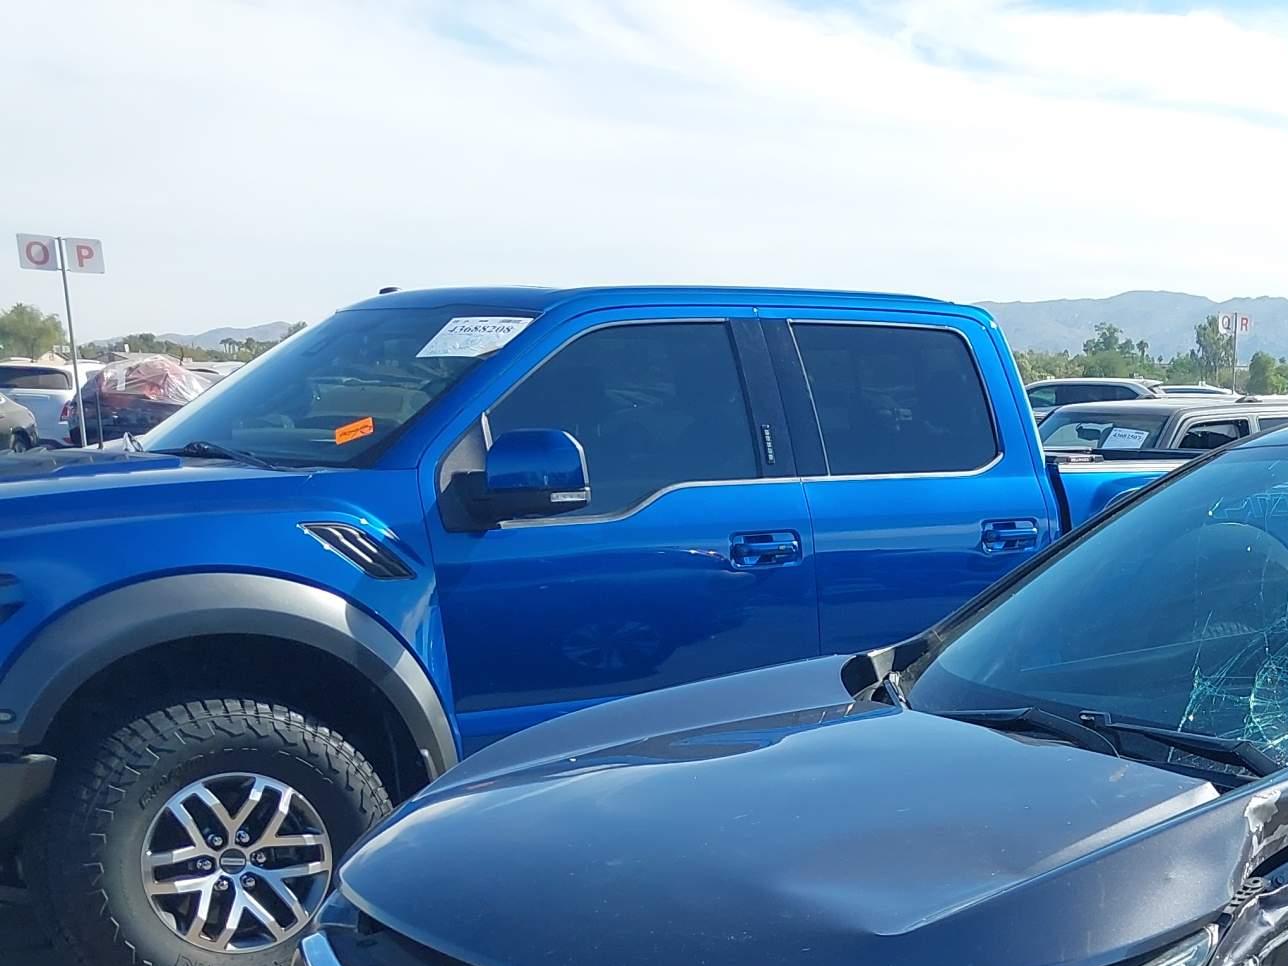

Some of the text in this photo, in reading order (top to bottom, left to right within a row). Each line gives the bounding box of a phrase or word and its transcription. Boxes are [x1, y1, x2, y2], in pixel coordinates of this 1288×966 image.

[26, 241, 49, 265] O
[76, 245, 94, 267] P
[1221, 315, 1232, 330] Q
[1240, 317, 1249, 331] R
